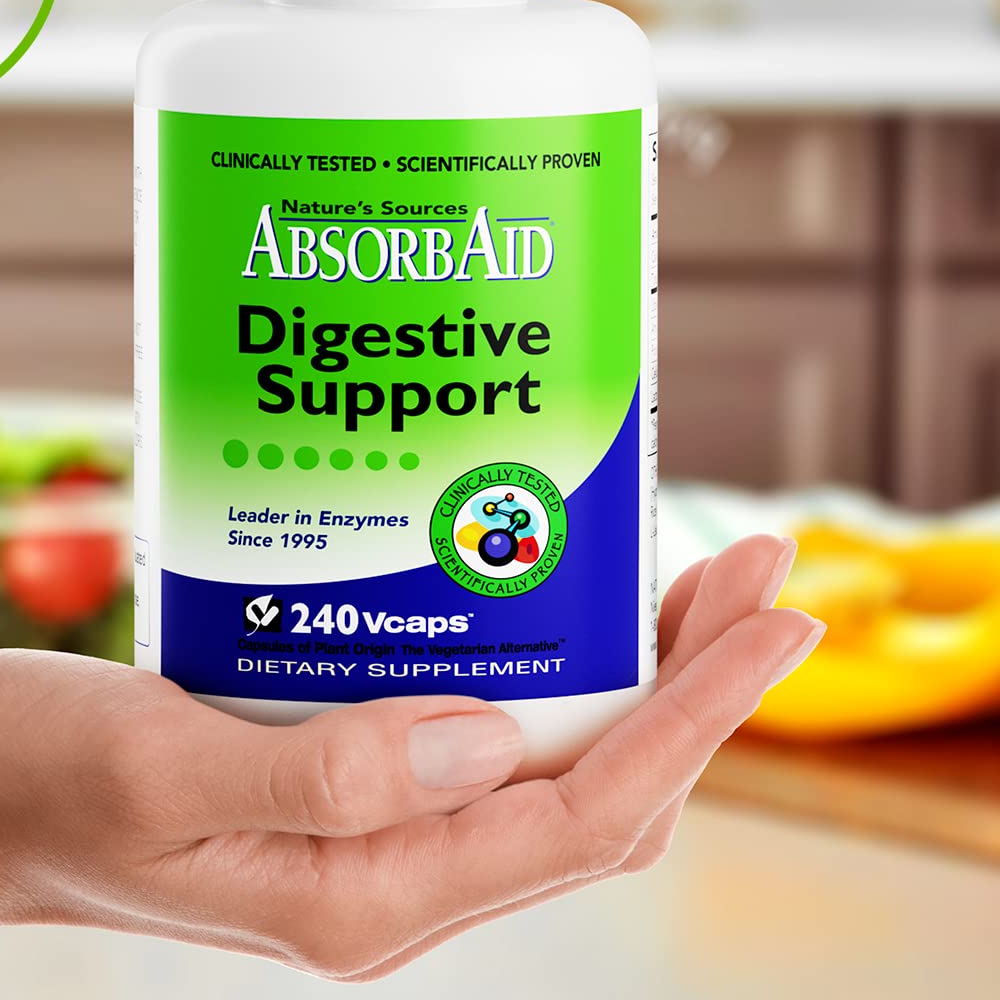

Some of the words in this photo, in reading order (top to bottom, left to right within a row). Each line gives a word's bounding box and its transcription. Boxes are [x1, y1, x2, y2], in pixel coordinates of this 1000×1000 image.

[211, 152, 303, 172] CLINICALLY
[306, 155, 377, 172] TESTED
[396, 154, 537, 172] SCIENTIFICALLY
[542, 152, 601, 169] PROVEN
[281, 199, 374, 215] Nature's
[380, 200, 469, 215] Sources
[238, 304, 551, 372] Digestive
[257, 364, 542, 432] Support
[440, 469, 513, 518] CLINICALLY
[518, 469, 560, 513] TESTED
[228, 506, 290, 525] Leader
[294, 510, 312, 525] in
[319, 511, 410, 531] Enzymes
[228, 530, 273, 548] Since
[280, 533, 329, 550] 1995
[436, 537, 527, 594] SCIENTIFICALLY
[531, 533, 564, 582] PROVEN
[290, 602, 359, 636] 240
[237, 638, 295, 655] Capsules
[297, 641, 311, 653] of
[315, 642, 350, 656] Plant
[353, 643, 396, 659] Origin
[401, 644, 425, 656] The
[428, 643, 496, 658] Vegetarian
[237, 658, 358, 676] DIETARY
[367, 658, 567, 678] SUPPLEMENT
